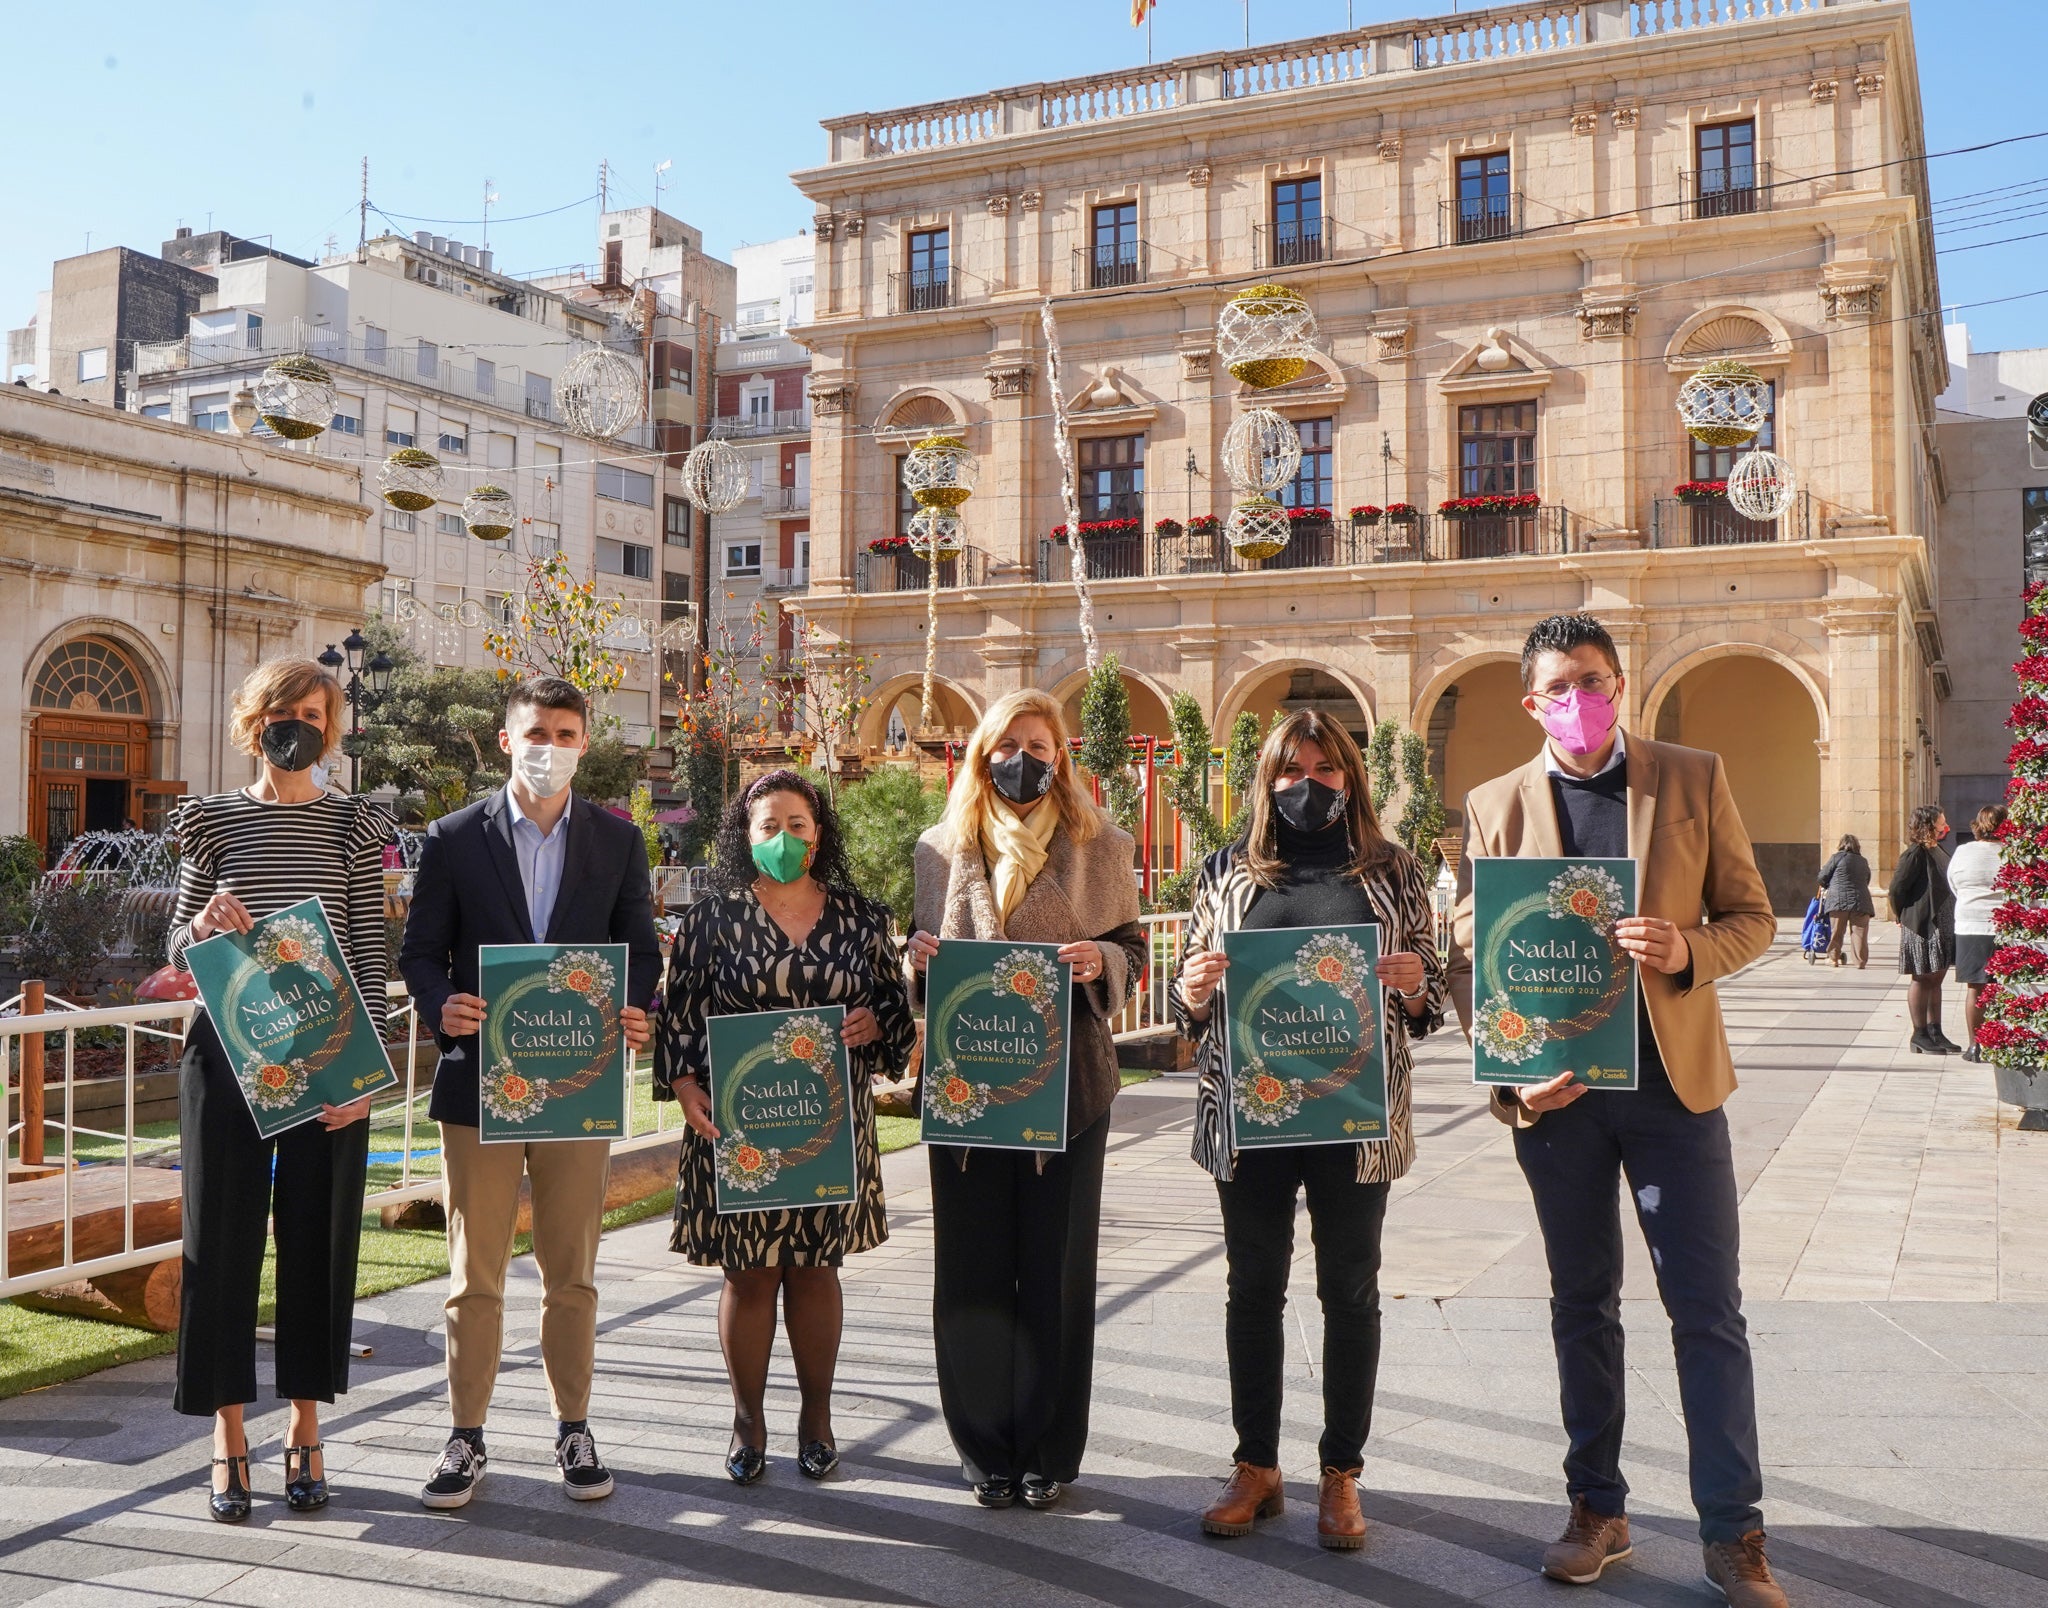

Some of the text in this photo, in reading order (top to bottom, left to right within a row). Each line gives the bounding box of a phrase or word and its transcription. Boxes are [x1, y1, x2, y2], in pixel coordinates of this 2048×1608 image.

[1508, 939, 1598, 960] Nadal a
[1507, 963, 1602, 984] Castelló
[1509, 984, 1600, 995] PROGRAMACIÓ 2021
[242, 981, 321, 1022] Nadal a
[251, 995, 332, 1040] Castelló
[512, 1010, 592, 1027] Nadal a
[956, 1013, 1035, 1034] Nadal a
[1261, 1004, 1346, 1025] Nadal a
[257, 1014, 335, 1050] PROGRAMACIÓ 2021
[511, 1030, 595, 1048] Castelló
[1261, 1025, 1351, 1047] Castelló
[512, 1049, 571, 1058] PROGRAMACIÓ
[955, 1034, 1038, 1056] Castelló
[1263, 1047, 1326, 1057] PROGRAMACIÓ
[956, 1055, 1014, 1064] PROGRAMACIÓ
[742, 1079, 818, 1101] Nadal a
[741, 1099, 822, 1120] Castelló
[744, 1118, 821, 1130] PROGRAMACIÓ 2021
